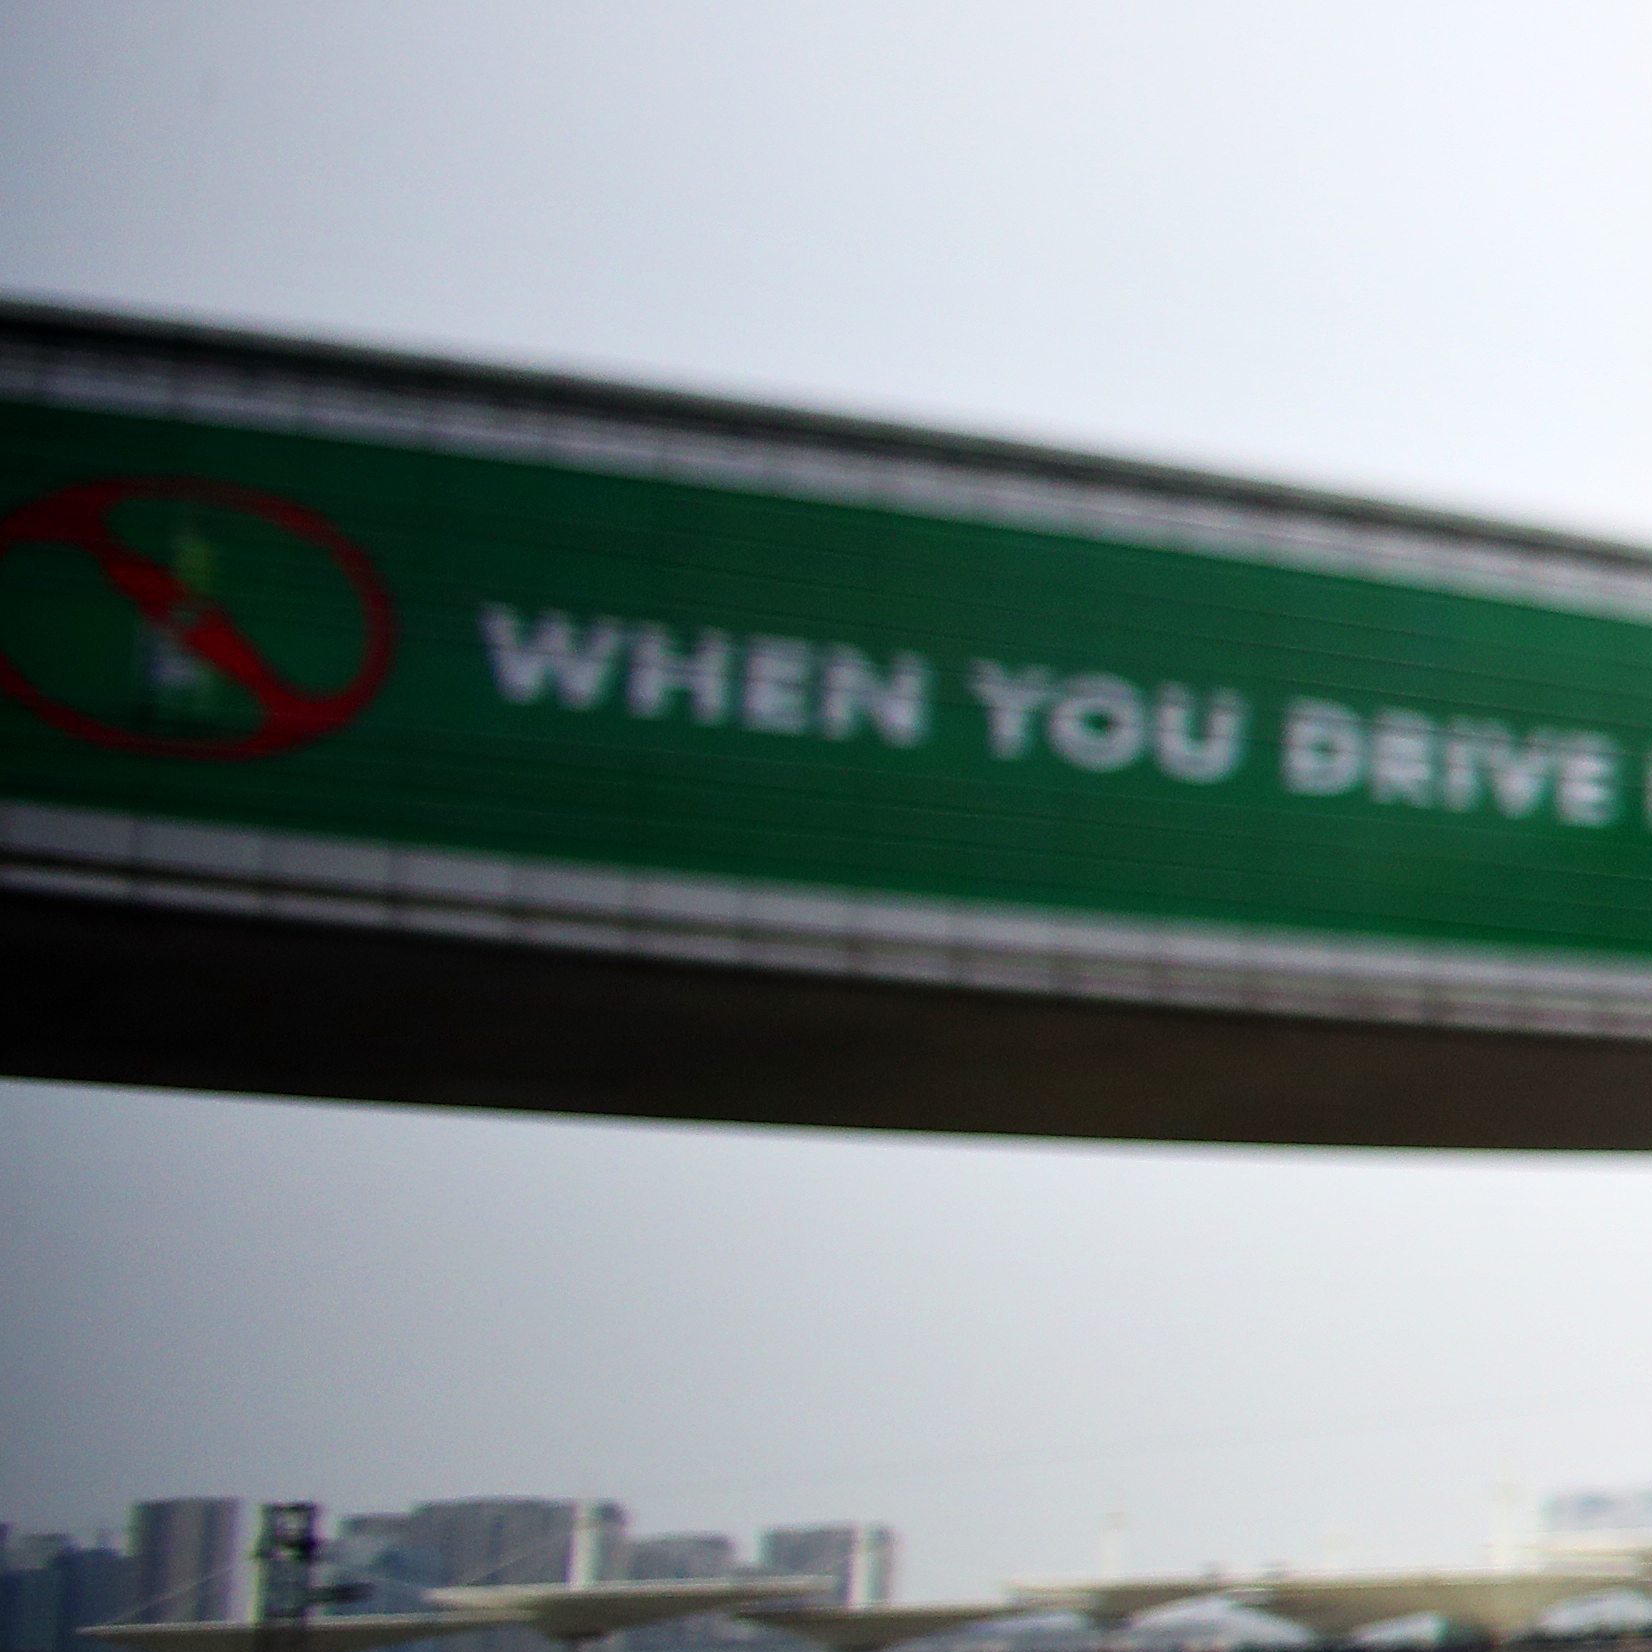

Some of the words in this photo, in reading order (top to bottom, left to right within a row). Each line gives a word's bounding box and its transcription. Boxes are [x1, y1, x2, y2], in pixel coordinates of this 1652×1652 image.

[483, 600, 930, 749] WHEN
[968, 656, 1246, 788] YOU
[1283, 696, 1623, 830] DRIVE
